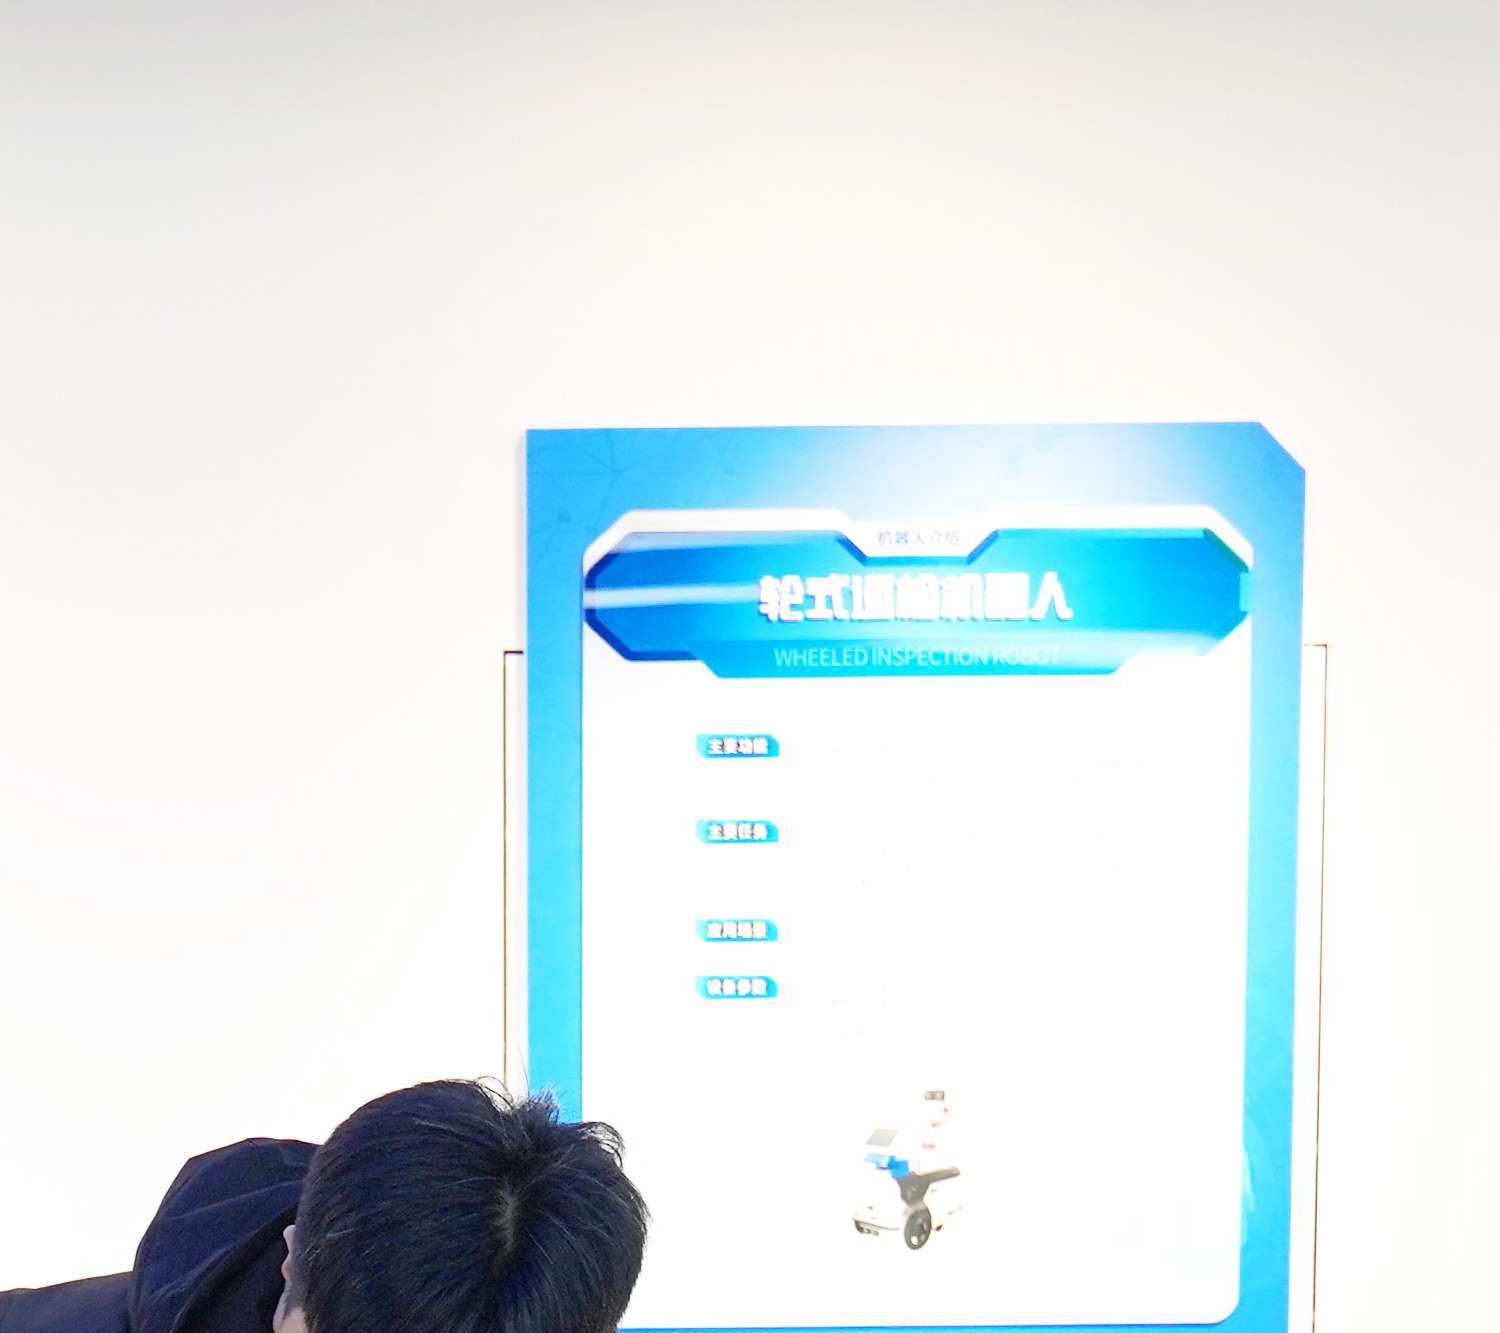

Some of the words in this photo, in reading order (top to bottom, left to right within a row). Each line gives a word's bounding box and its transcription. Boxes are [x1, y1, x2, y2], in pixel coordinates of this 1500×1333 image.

[877, 528, 961, 547] 机器人介绍
[758, 571, 1074, 623] 轮式巡检机器人
[774, 647, 868, 667] WHEELED
[872, 646, 988, 667] INSPECTION
[992, 645, 1059, 666] ROBOT
[707, 736, 768, 755] 主要功能
[707, 822, 768, 841] 主要任务
[706, 921, 768, 940] 应用场景
[706, 978, 768, 997] 设备参数
